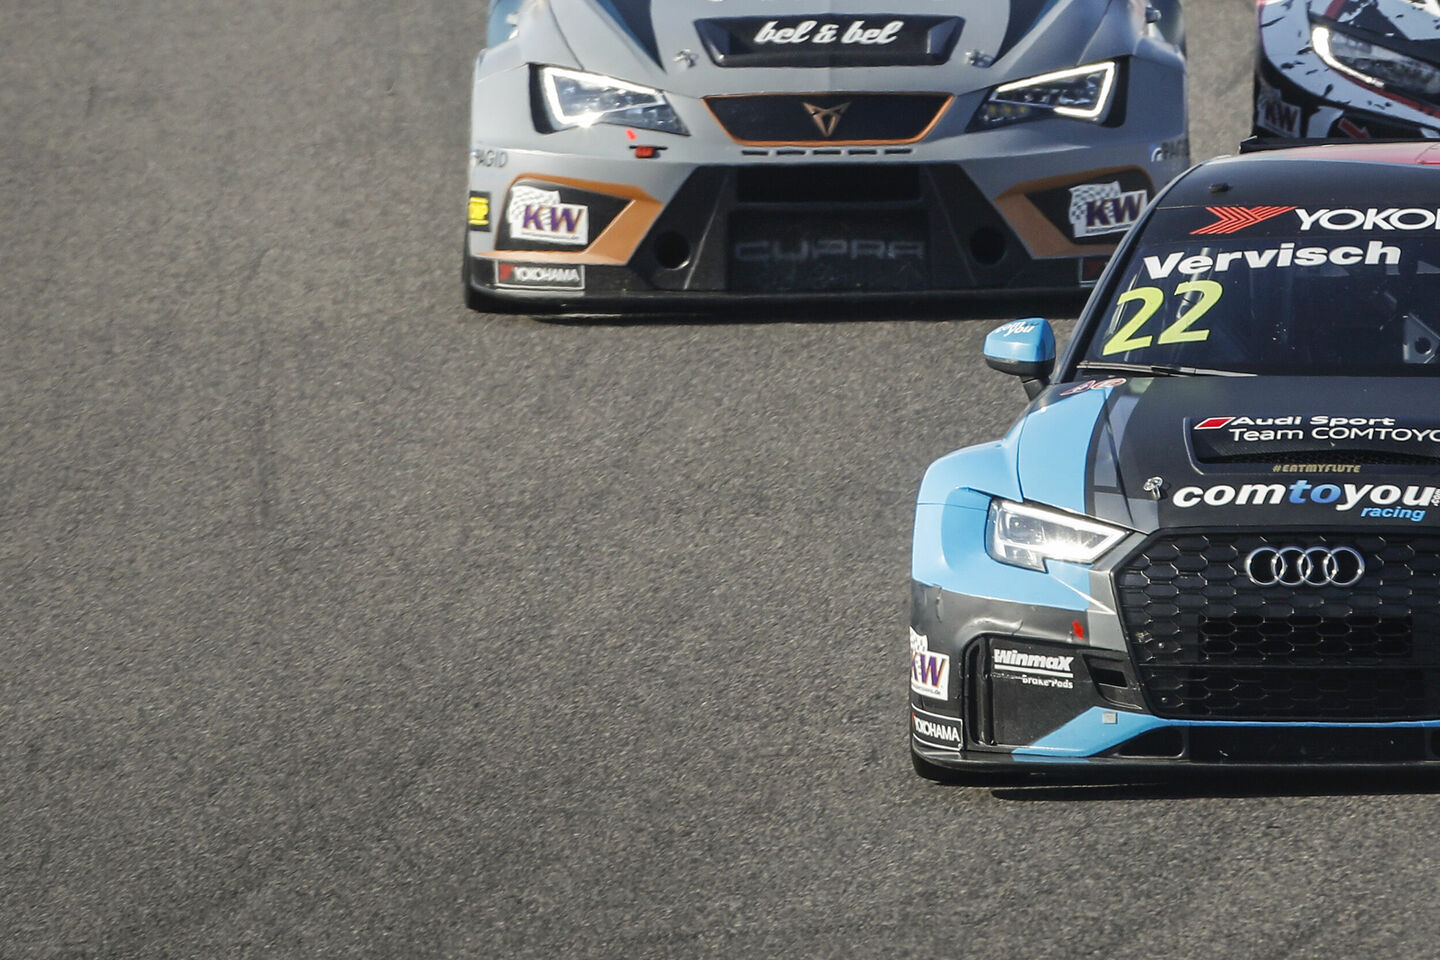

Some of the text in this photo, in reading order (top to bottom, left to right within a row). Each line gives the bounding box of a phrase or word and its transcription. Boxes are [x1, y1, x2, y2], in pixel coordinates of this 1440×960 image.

[753, 20, 818, 45] bel
[840, 20, 905, 45] bel
[522, 203, 585, 234] KW
[1085, 192, 1144, 228] KW
[1143, 240, 1402, 280] Vervisch
[512, 266, 581, 283] YOKOHAMA
[1101, 280, 1224, 357] 22
[1229, 415, 1396, 427] Audi Sport
[1228, 427, 1304, 442] Team
[1271, 464, 1362, 474] #EATMYFLUTE
[1172, 479, 1437, 512] comtoyou
[1360, 505, 1427, 523] racing
